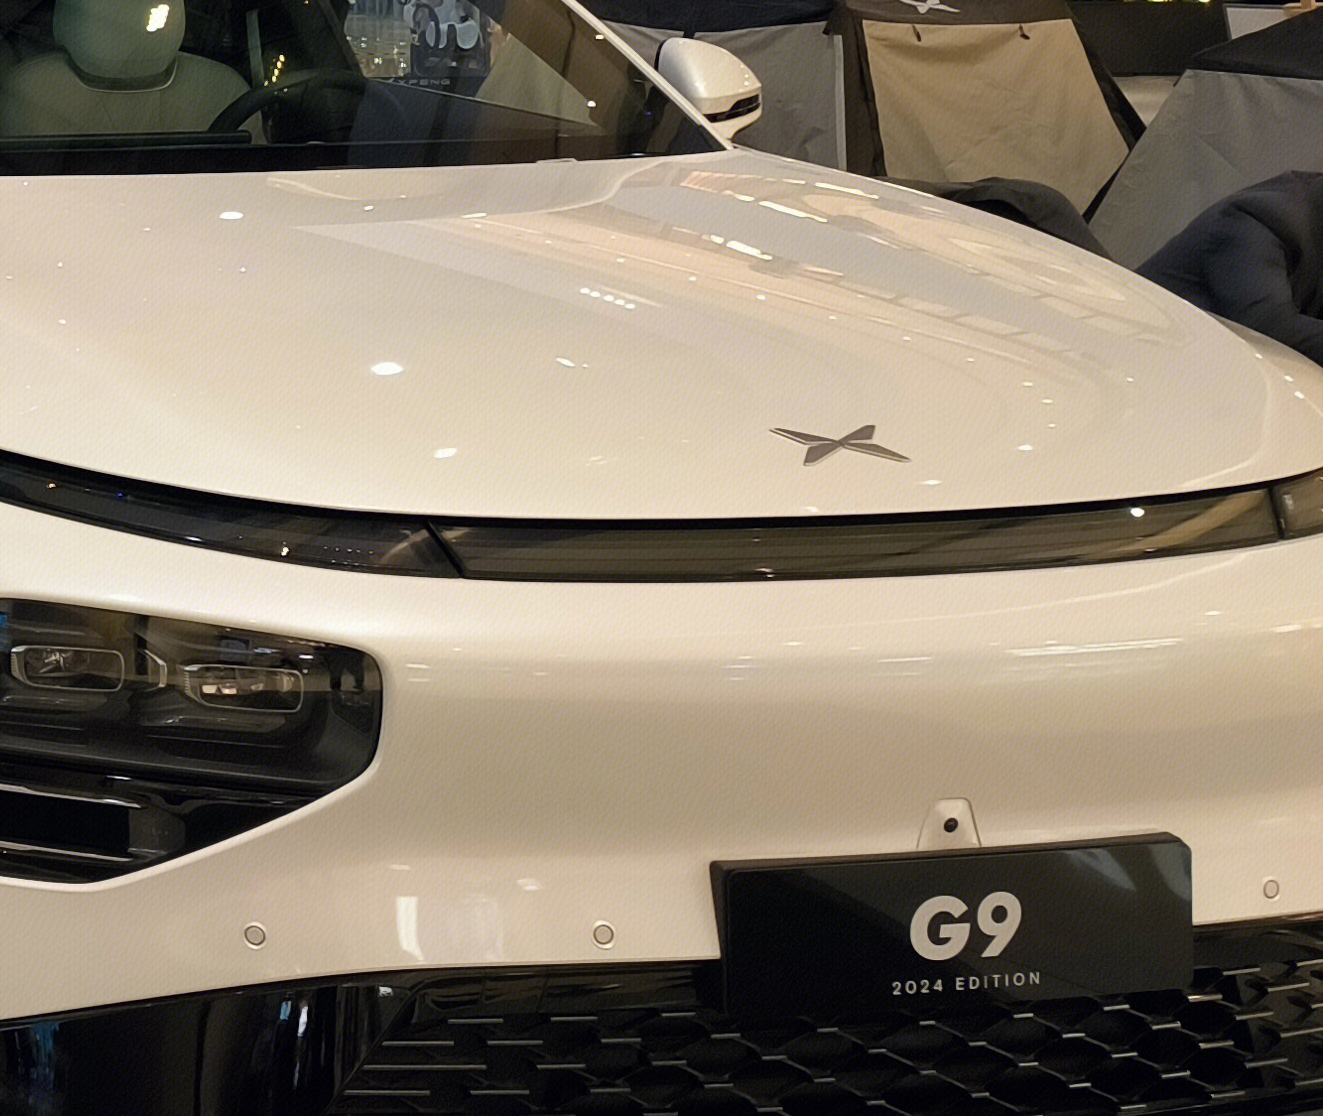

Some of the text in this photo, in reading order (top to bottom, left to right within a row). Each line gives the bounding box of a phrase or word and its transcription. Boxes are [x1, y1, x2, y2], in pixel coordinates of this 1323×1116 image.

[909, 891, 1023, 962] G9
[891, 971, 1041, 996] 2024 EDITION
